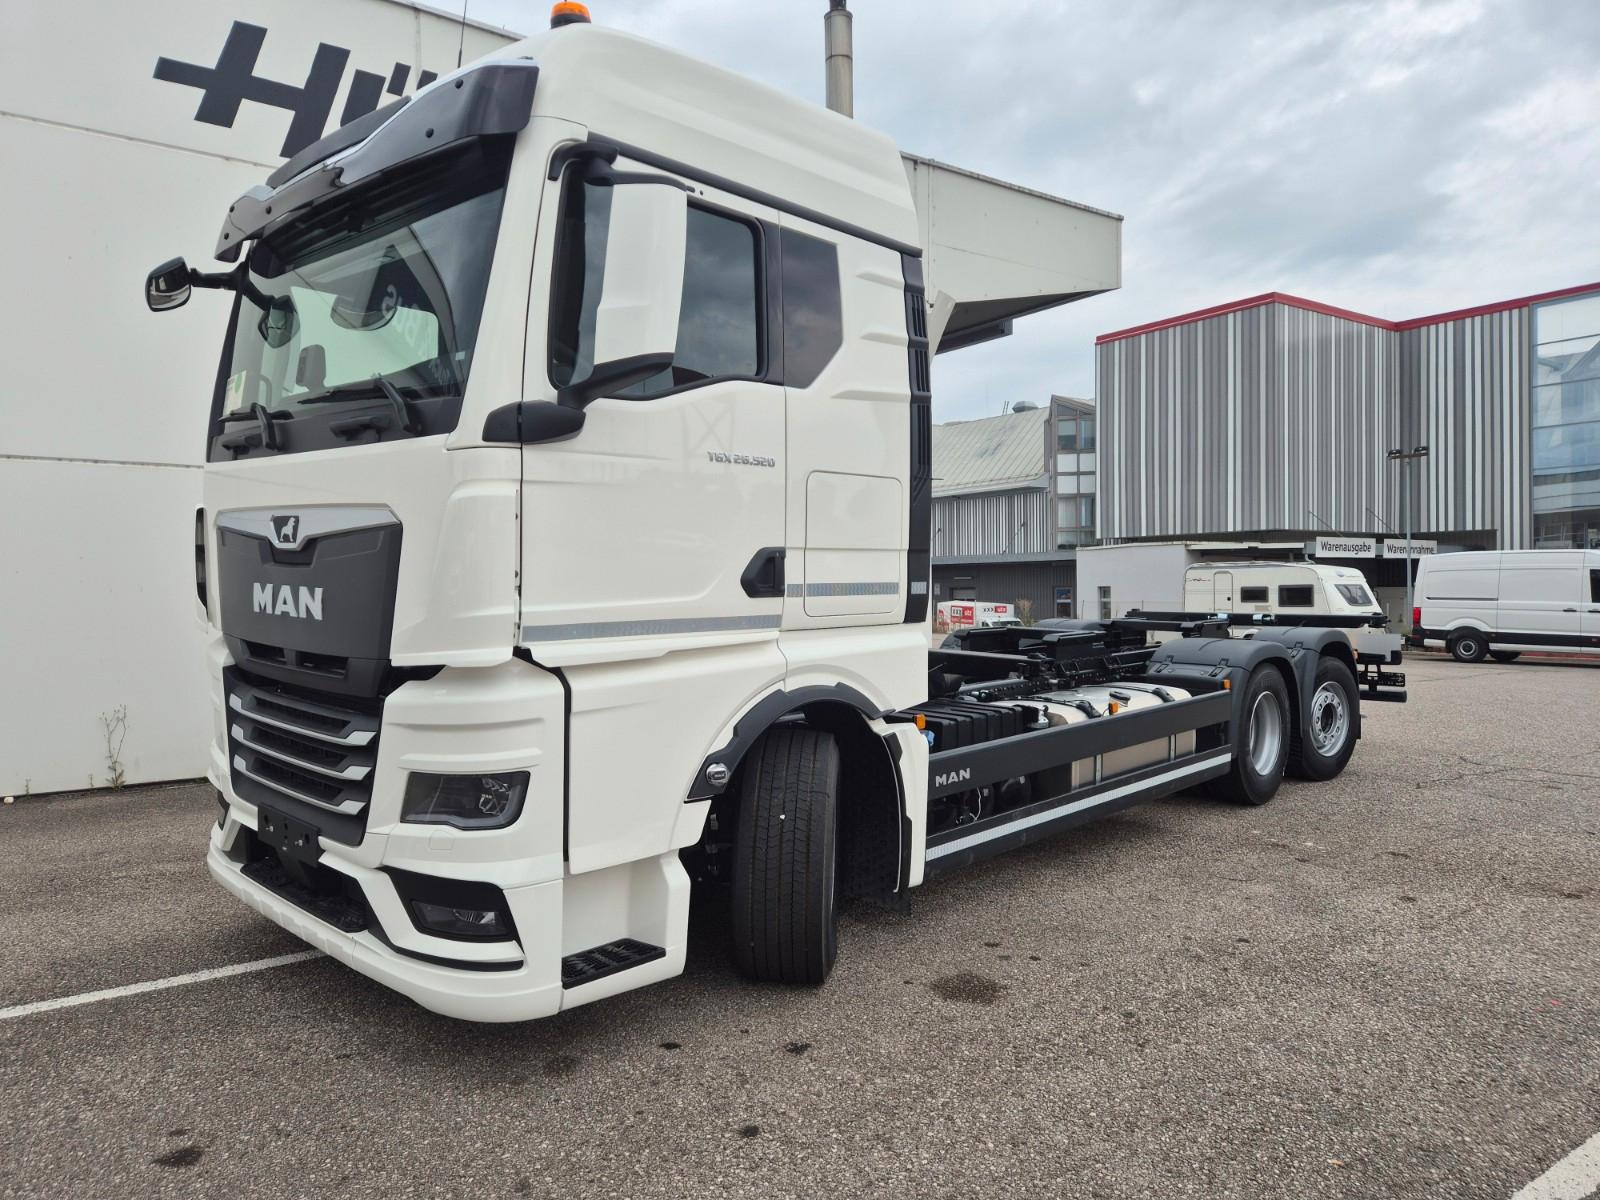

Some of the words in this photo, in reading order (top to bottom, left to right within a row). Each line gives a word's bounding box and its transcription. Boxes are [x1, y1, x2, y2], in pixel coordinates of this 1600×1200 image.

[733, 454, 776, 468] 26.520
[1320, 541, 1372, 555] Warenausgabe
[1387, 543, 1434, 555] Warennnahme
[253, 582, 324, 621] MAN
[935, 767, 971, 788] MAN
